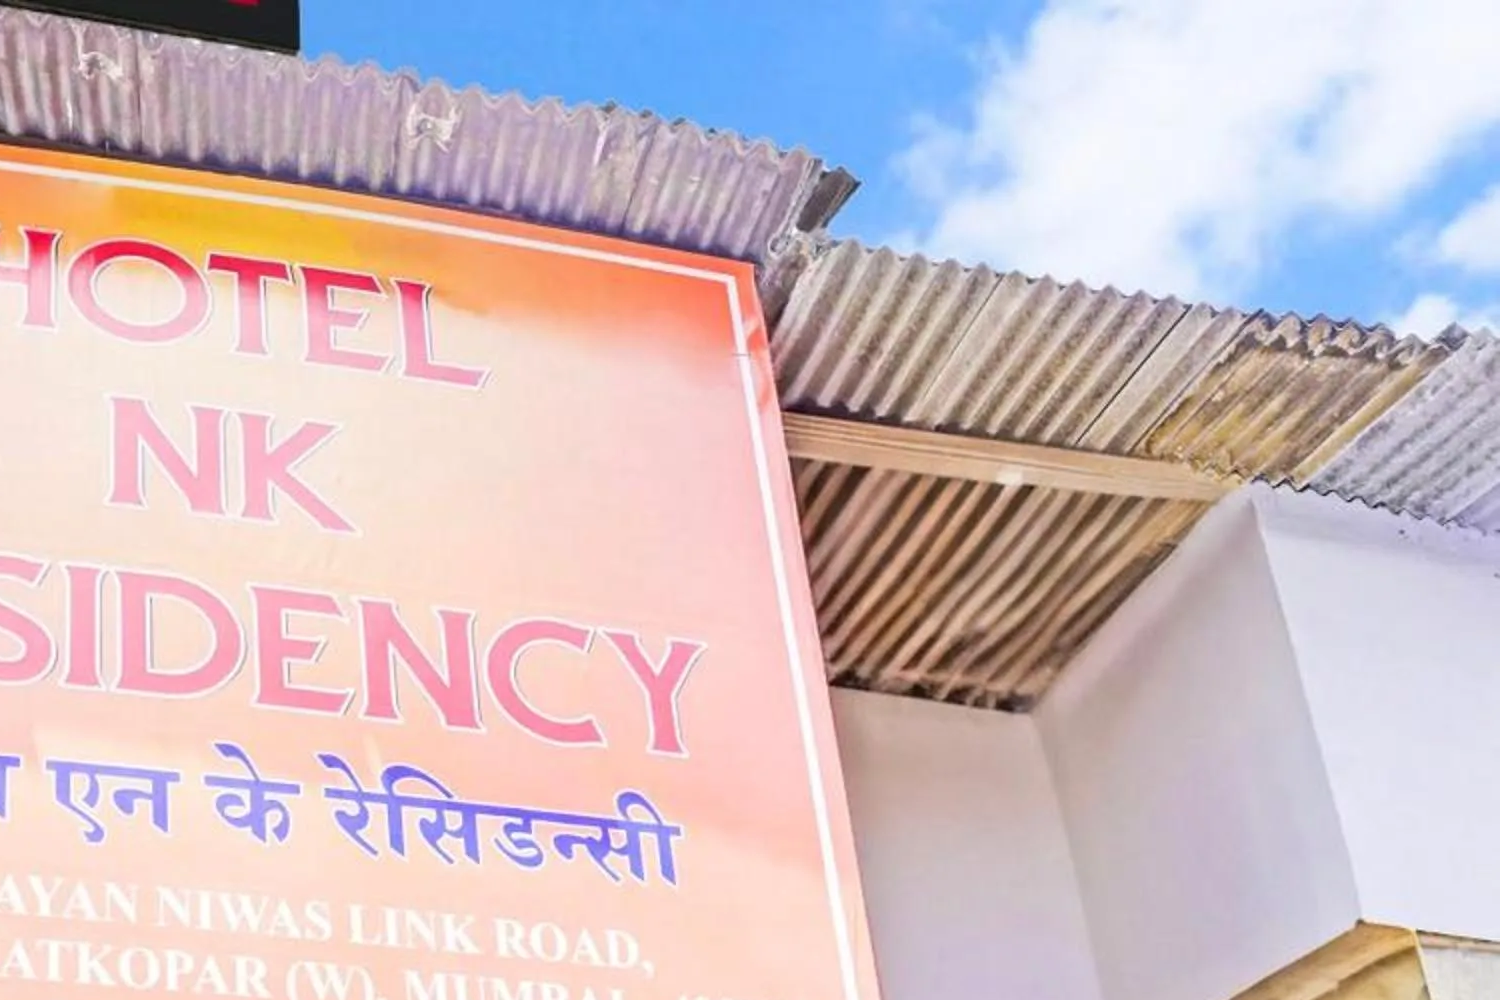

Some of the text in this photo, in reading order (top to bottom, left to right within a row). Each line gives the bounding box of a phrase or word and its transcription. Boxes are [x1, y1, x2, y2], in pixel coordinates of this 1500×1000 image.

[104, 397, 357, 532] NK
[45, 757, 180, 845] एन
[203, 741, 301, 847] के
[316, 752, 683, 887] रेसिडन्सी
[157, 886, 332, 944] NIWAS
[348, 902, 483, 956] LINK
[494, 917, 654, 977] ROAD,
